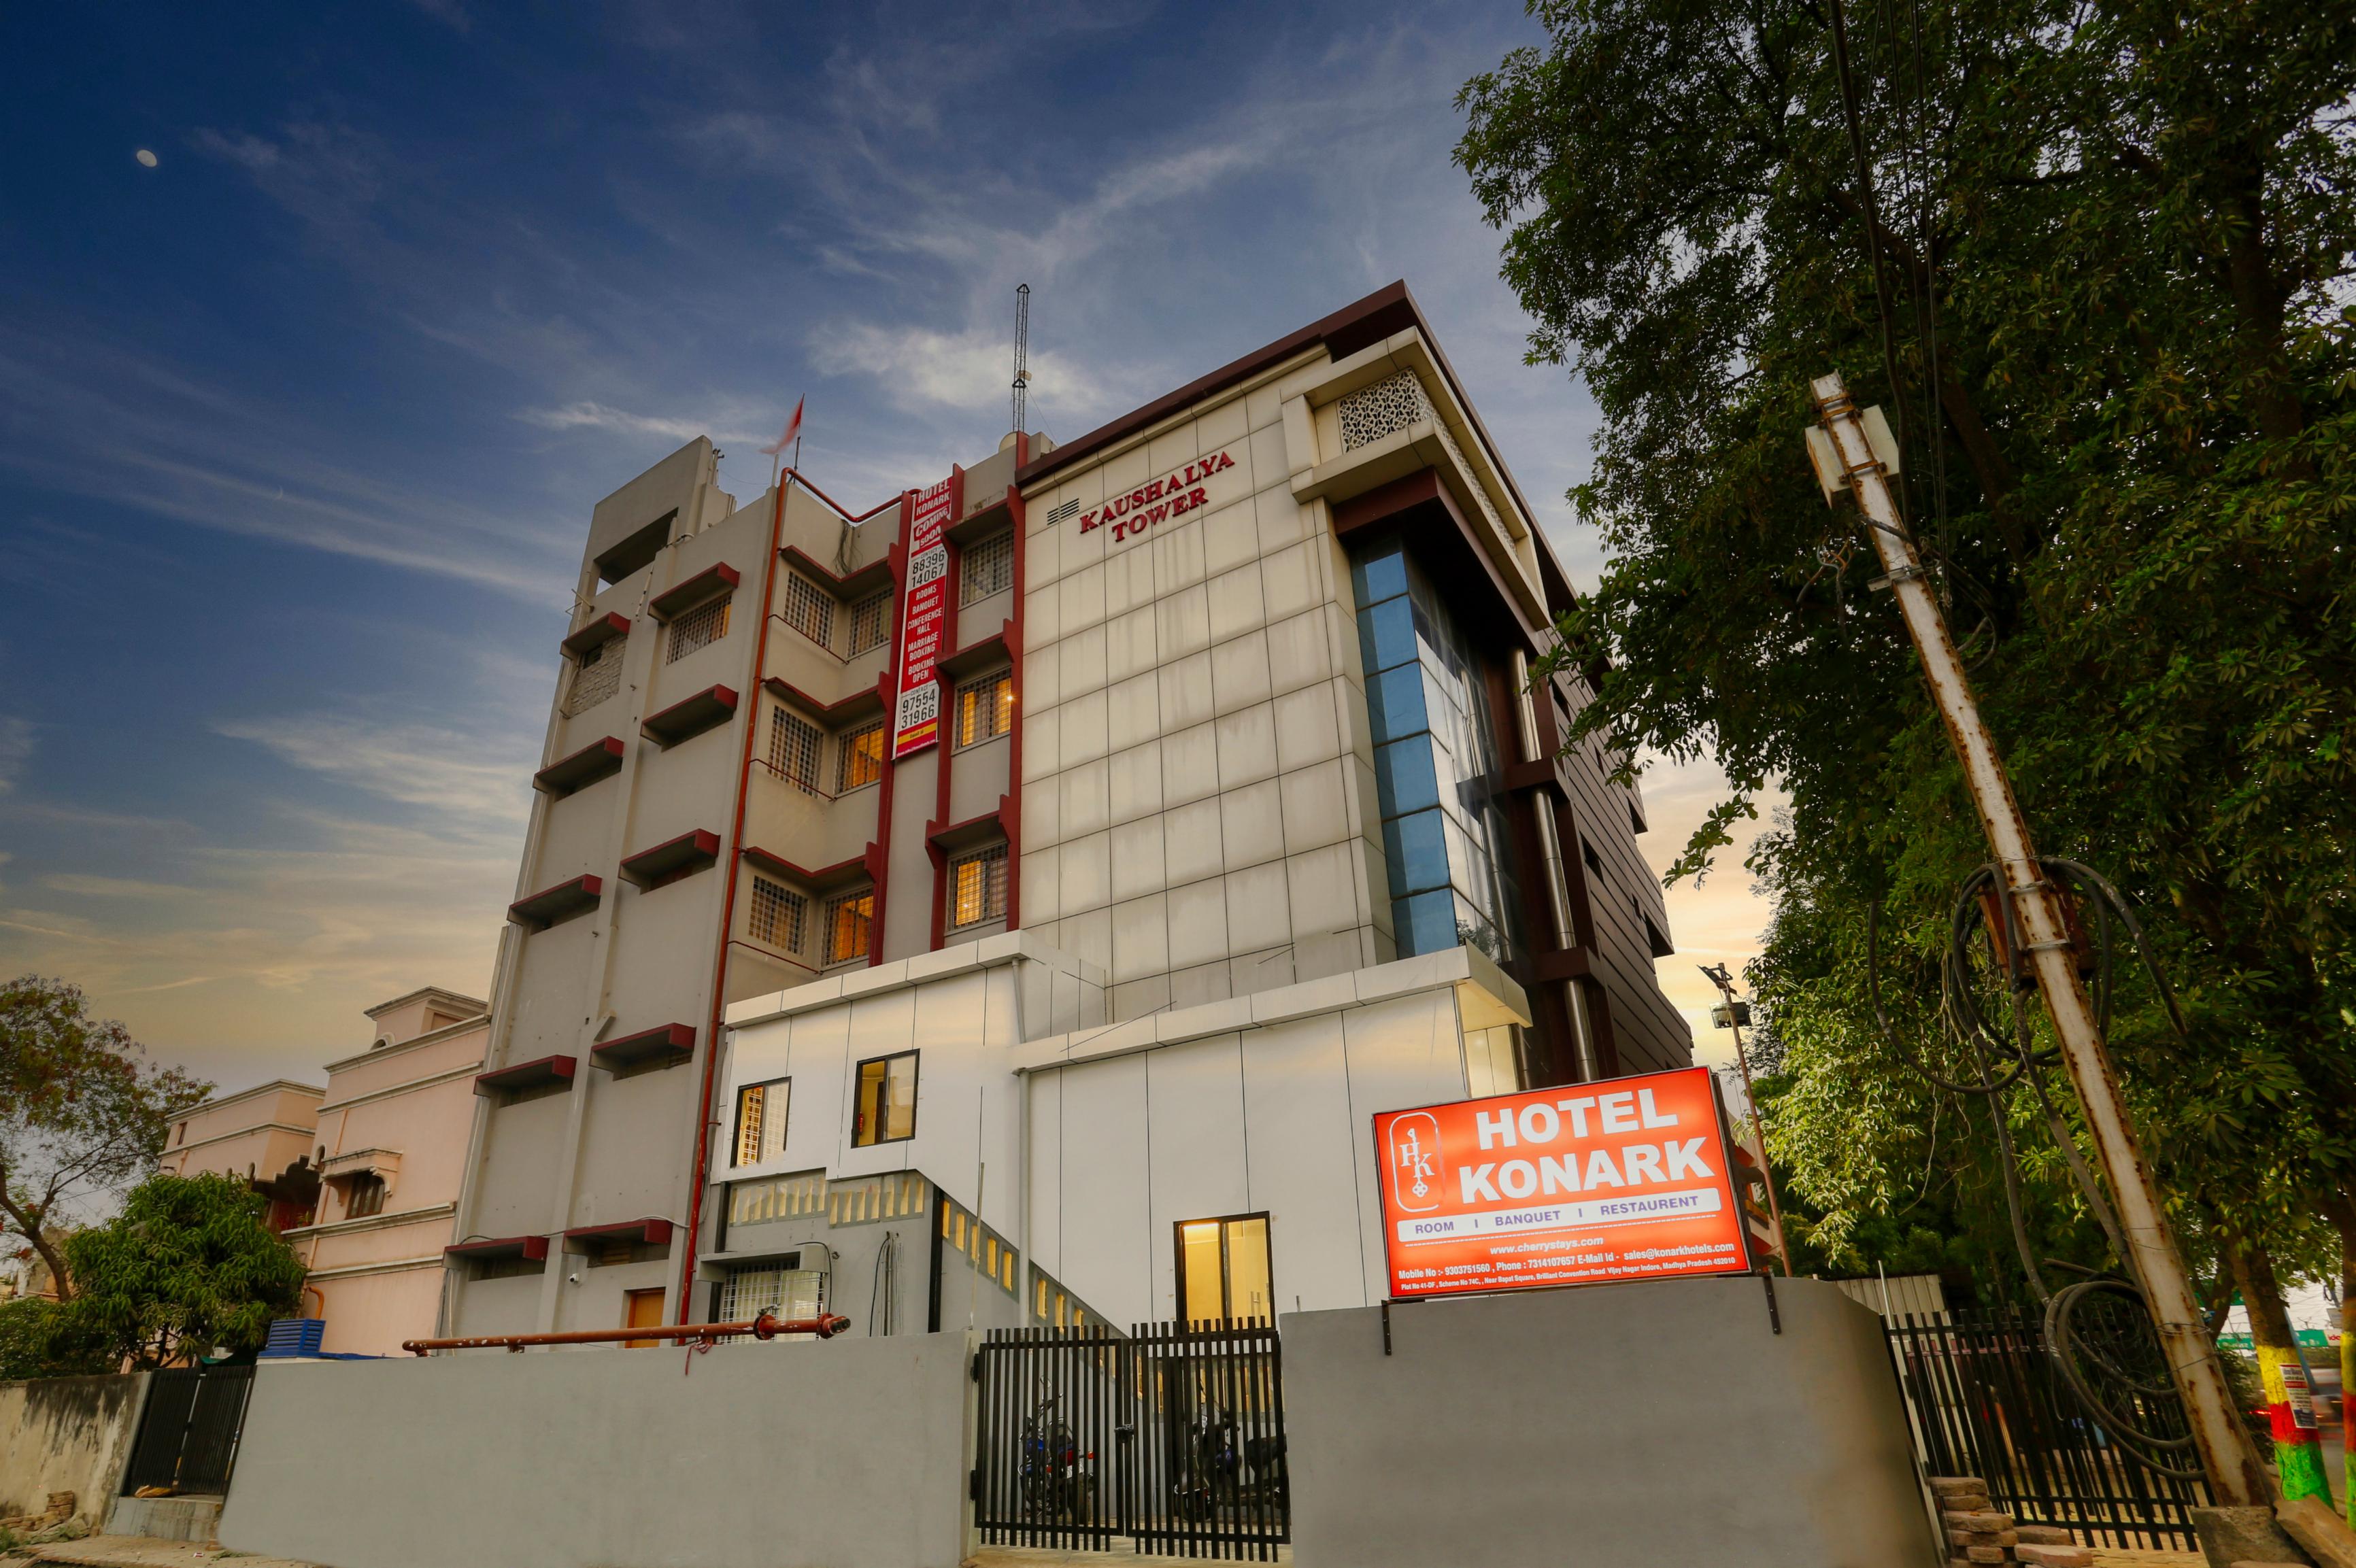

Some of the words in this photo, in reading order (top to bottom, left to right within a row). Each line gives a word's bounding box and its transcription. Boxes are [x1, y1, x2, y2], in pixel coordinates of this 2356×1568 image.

[917, 491, 950, 516] KONARK
[1080, 451, 1235, 534] KAUSHALYA
[915, 507, 947, 536] COMING
[1112, 487, 1209, 543] TOWER
[913, 550, 944, 574] 88396
[911, 564, 943, 587] 14067
[916, 585, 937, 600] ROOMS
[912, 596, 939, 615] BANQUET
[907, 607, 942, 630] CONFERENCE
[917, 622, 930, 635] HALL
[908, 632, 939, 652] MARRIAGE
[909, 643, 935, 662] BOOKING
[908, 657, 935, 675] BOOKING
[913, 669, 929, 683] OPEN
[903, 689, 935, 713] 97554
[911, 685, 928, 696] CONTACT
[901, 704, 934, 728] 31966
[1475, 1088, 1679, 1150] HOTEL
[1459, 1137, 1715, 1204] KONARK
[1415, 1221, 1454, 1234] ROOM
[1495, 1210, 1561, 1226] BANQUET
[1600, 1196, 1698, 1216] RESTAURENT
[1490, 1237, 1604, 1255] www.cherrystays.com
[1398, 1269, 1424, 1279] Mobile
[1425, 1268, 1436, 1277] No
[1445, 1263, 1490, 1276] 9303751560
[1496, 1261, 1521, 1271] Phone
[1528, 1256, 1575, 1269] 7314107657
[1577, 1252, 1604, 1264] E-Mail
[1623, 1243, 1735, 1261] sales@konarkhotels.com
[1438, 1280, 1460, 1288] Scheme
[1498, 1276, 1514, 1284] Bapat
[1514, 1274, 1536, 1282] Square,
[1558, 1269, 1590, 1278] Convention
[1607, 1267, 1621, 1275] Vijay
[1622, 1265, 1640, 1274] Nagar
[1662, 1261, 1686, 1269] Madhya
[1687, 1259, 1713, 1267] Pradesh
[1713, 1257, 1736, 1265] 452010
